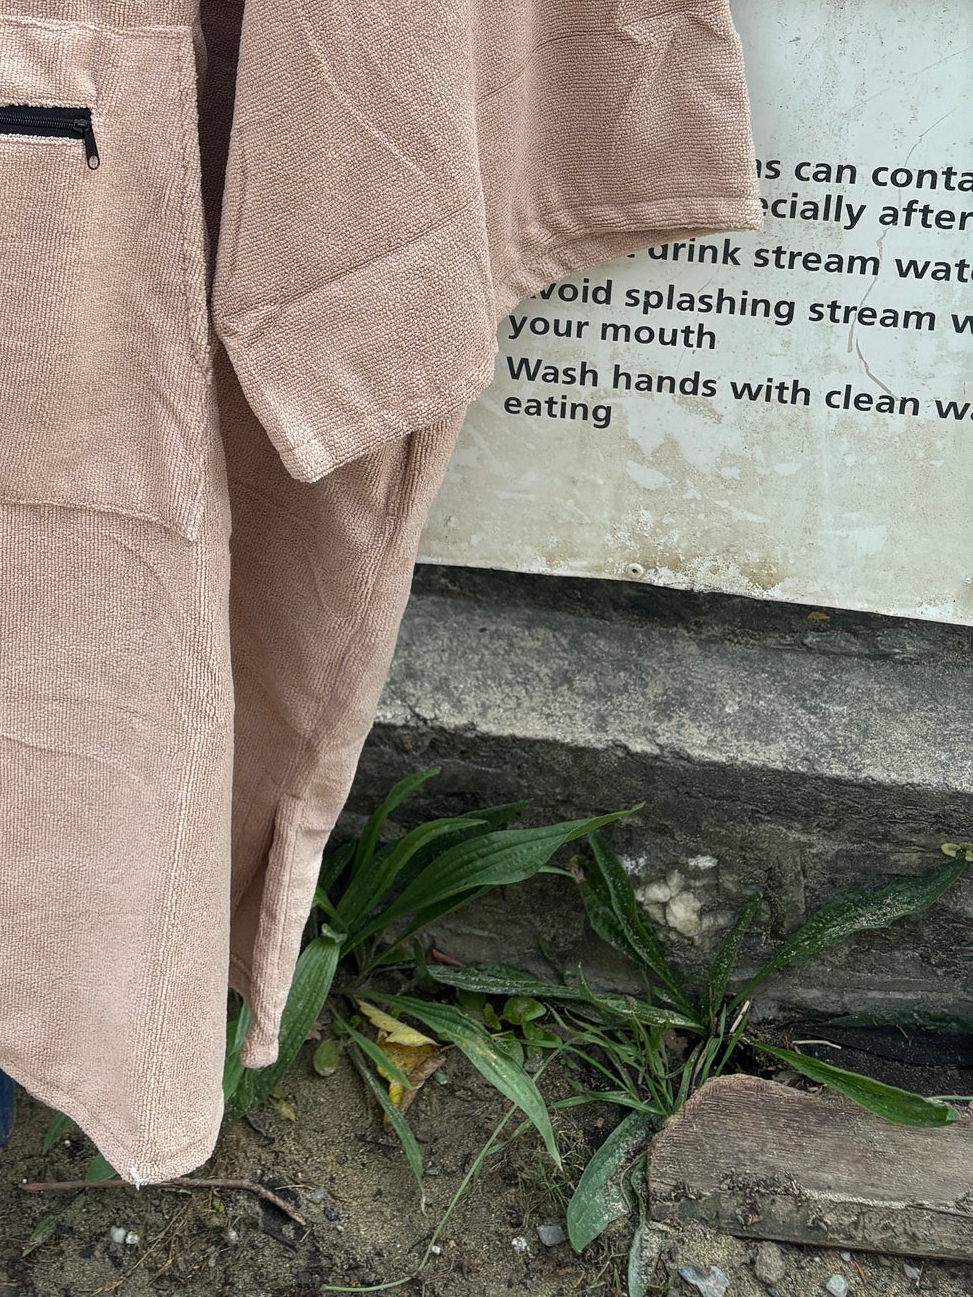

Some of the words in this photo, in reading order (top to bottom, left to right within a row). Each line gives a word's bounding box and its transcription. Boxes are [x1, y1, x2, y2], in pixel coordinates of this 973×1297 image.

[795, 160, 856, 185] can
[878, 199, 973, 231] after
[753, 245, 880, 276] stream
[895, 255, 973, 283] wat
[529, 278, 613, 306] void
[624, 284, 795, 325] splashing
[808, 300, 936, 332] stream
[508, 312, 590, 340] your
[602, 320, 717, 350] mouth
[506, 356, 598, 388] Wash
[612, 364, 718, 398] hands
[730, 379, 811, 406] with
[824, 384, 920, 416] clean
[503, 395, 613, 430] eating
